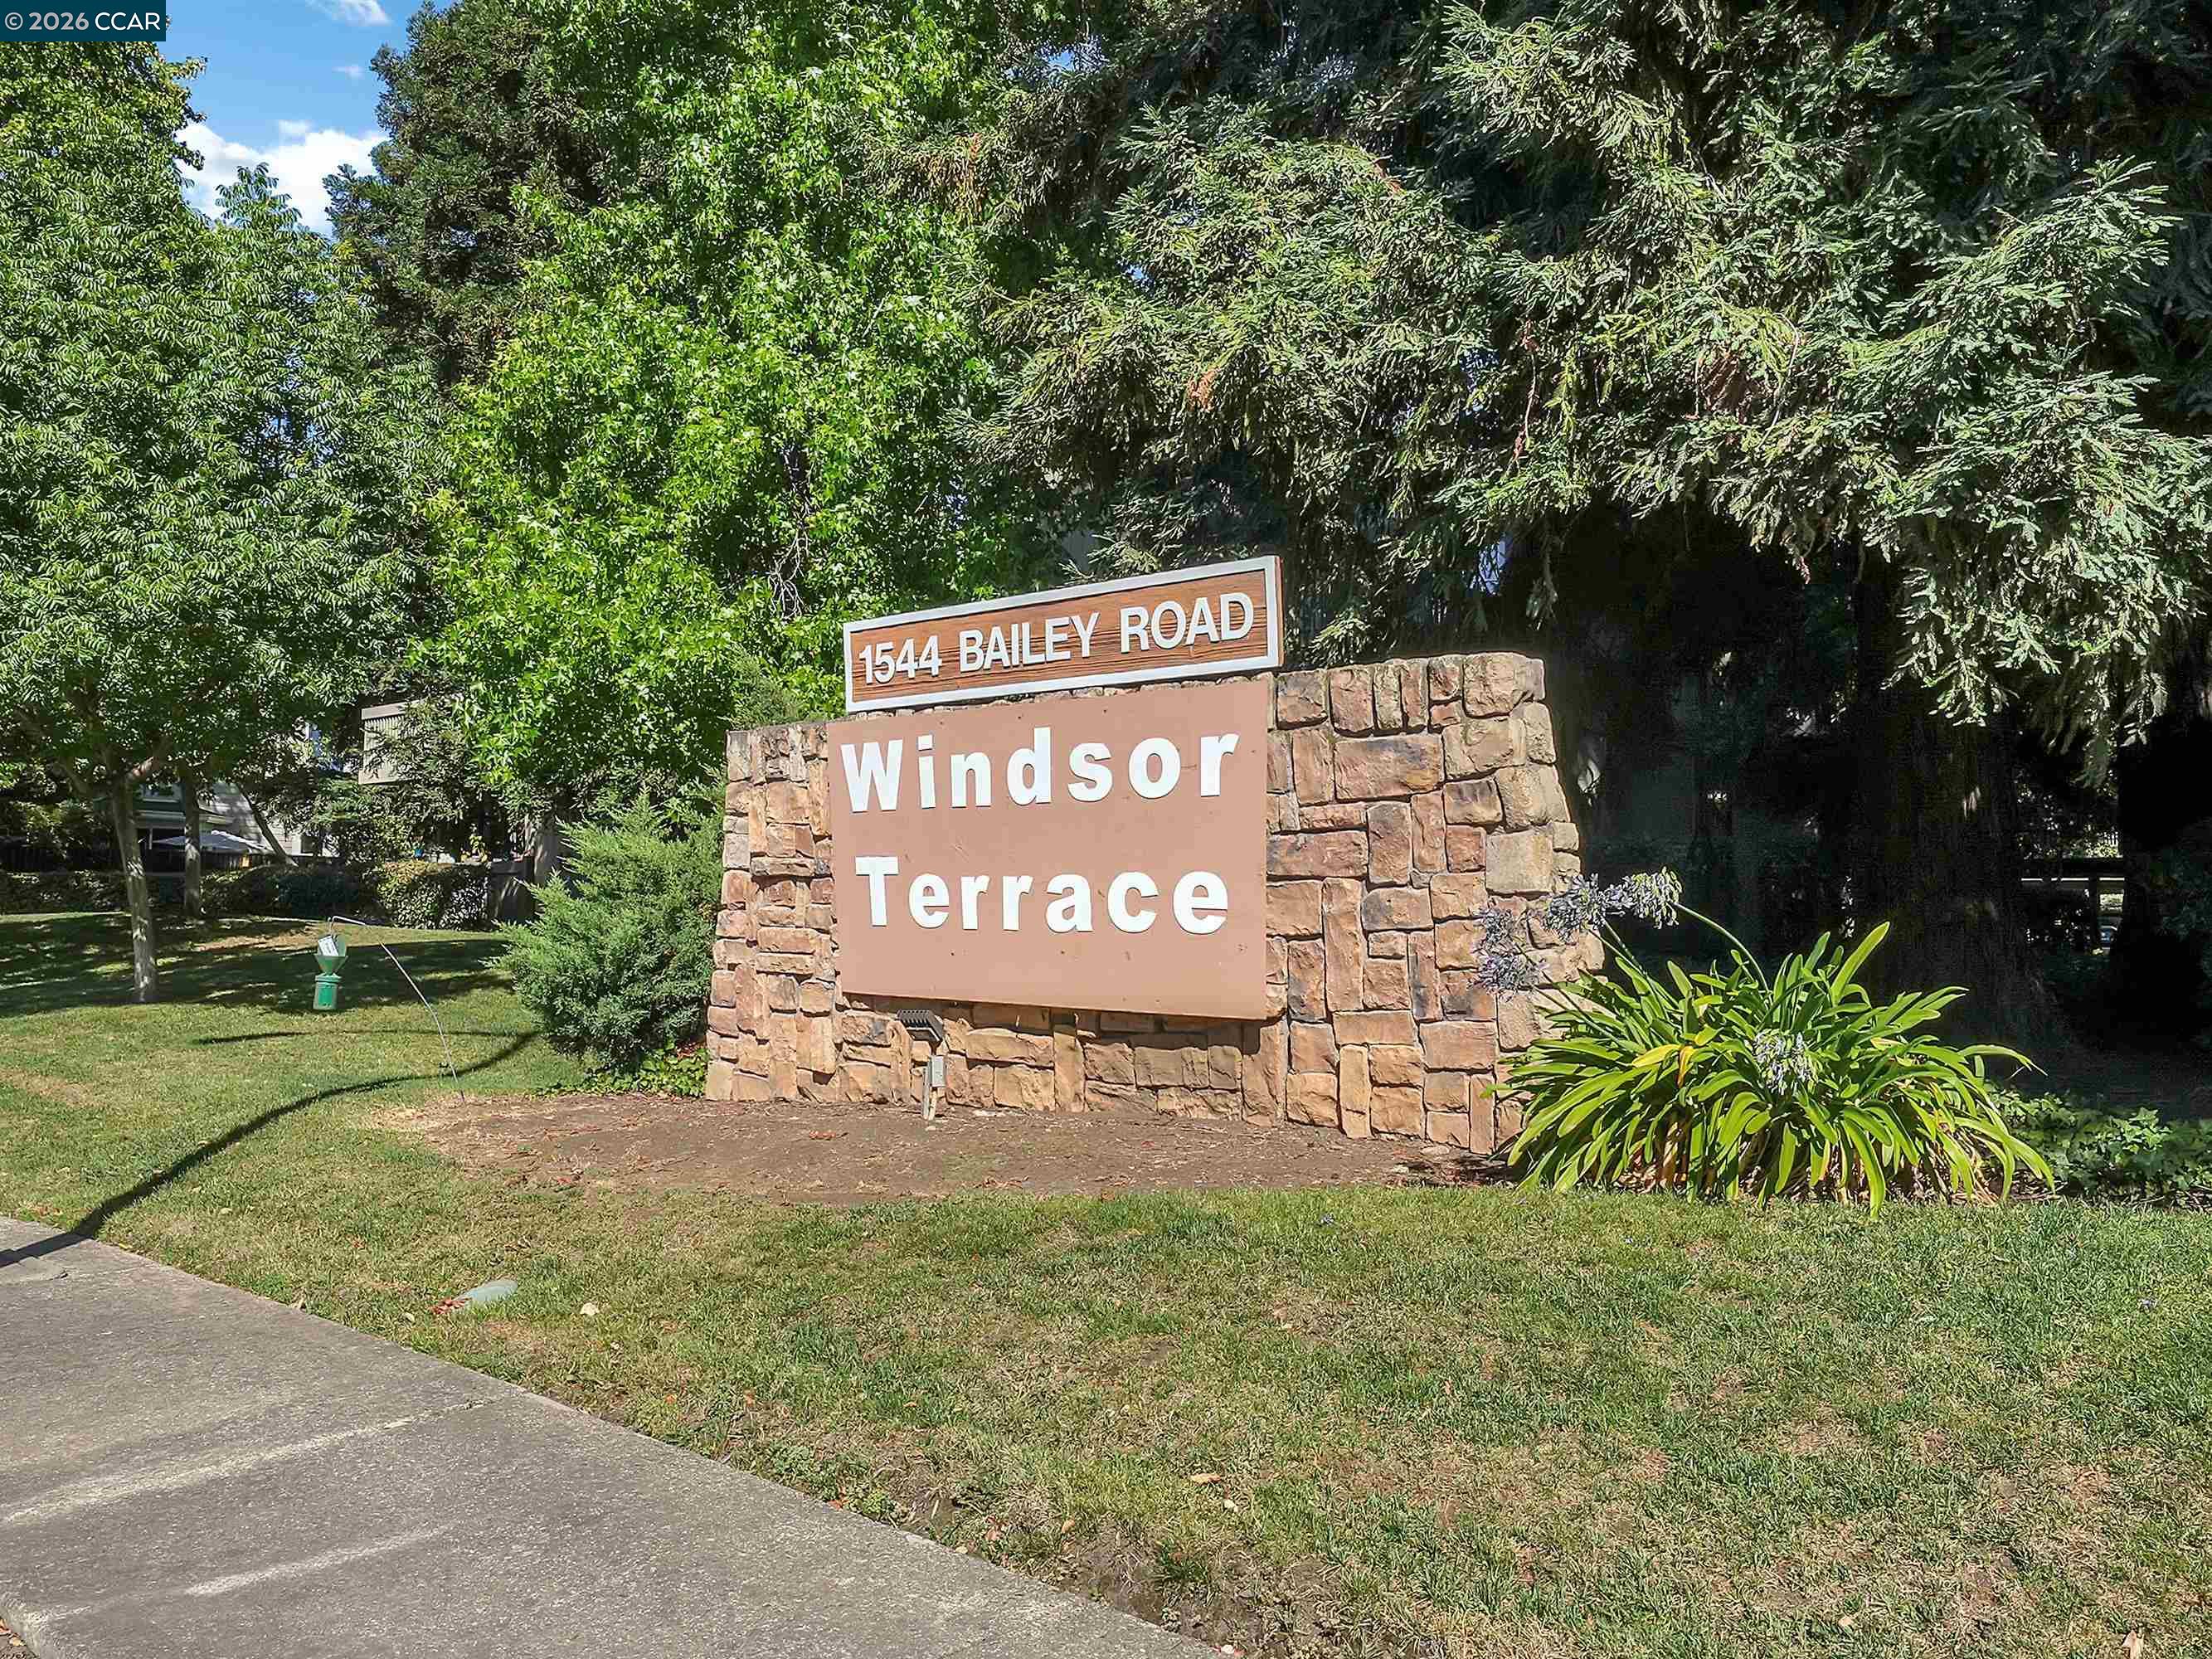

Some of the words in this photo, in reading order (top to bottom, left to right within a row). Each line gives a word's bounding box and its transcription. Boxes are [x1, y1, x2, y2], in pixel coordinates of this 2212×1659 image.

[858, 635, 942, 684] 1544
[960, 612, 1101, 673] BAILEY
[1121, 592, 1255, 654] ROAD
[840, 727, 1241, 813] Windsor
[854, 856, 1229, 935] Terrace
